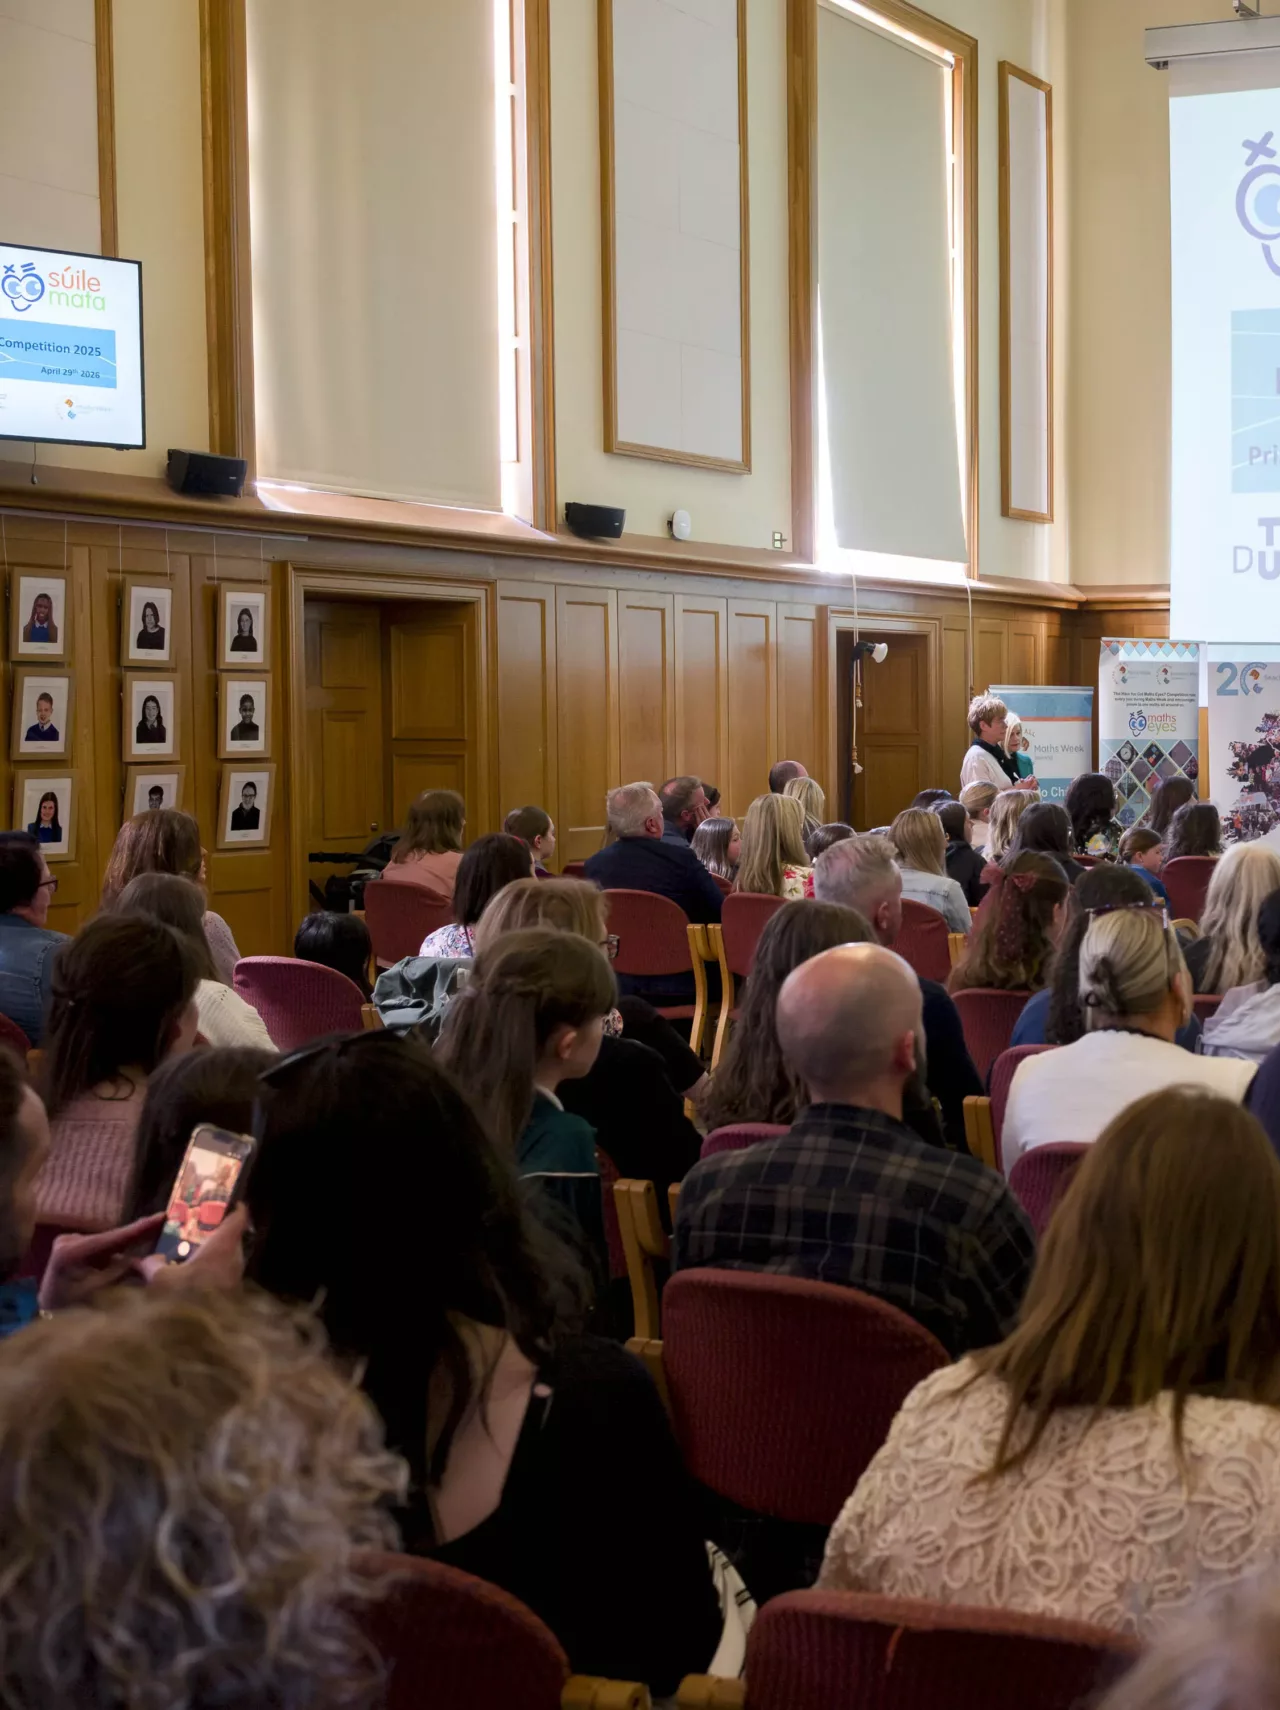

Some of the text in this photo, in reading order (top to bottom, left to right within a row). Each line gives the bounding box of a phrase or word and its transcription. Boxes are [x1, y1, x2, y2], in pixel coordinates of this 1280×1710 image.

[48, 266, 101, 292] súile
[49, 290, 106, 311] mata
[74, 344, 101, 357] 2025
[40, 366, 61, 377] April
[80, 370, 100, 379] 2026
[1147, 713, 1176, 723] maths
[1147, 722, 1177, 735] eyes
[1034, 744, 1084, 753] Maths Week
